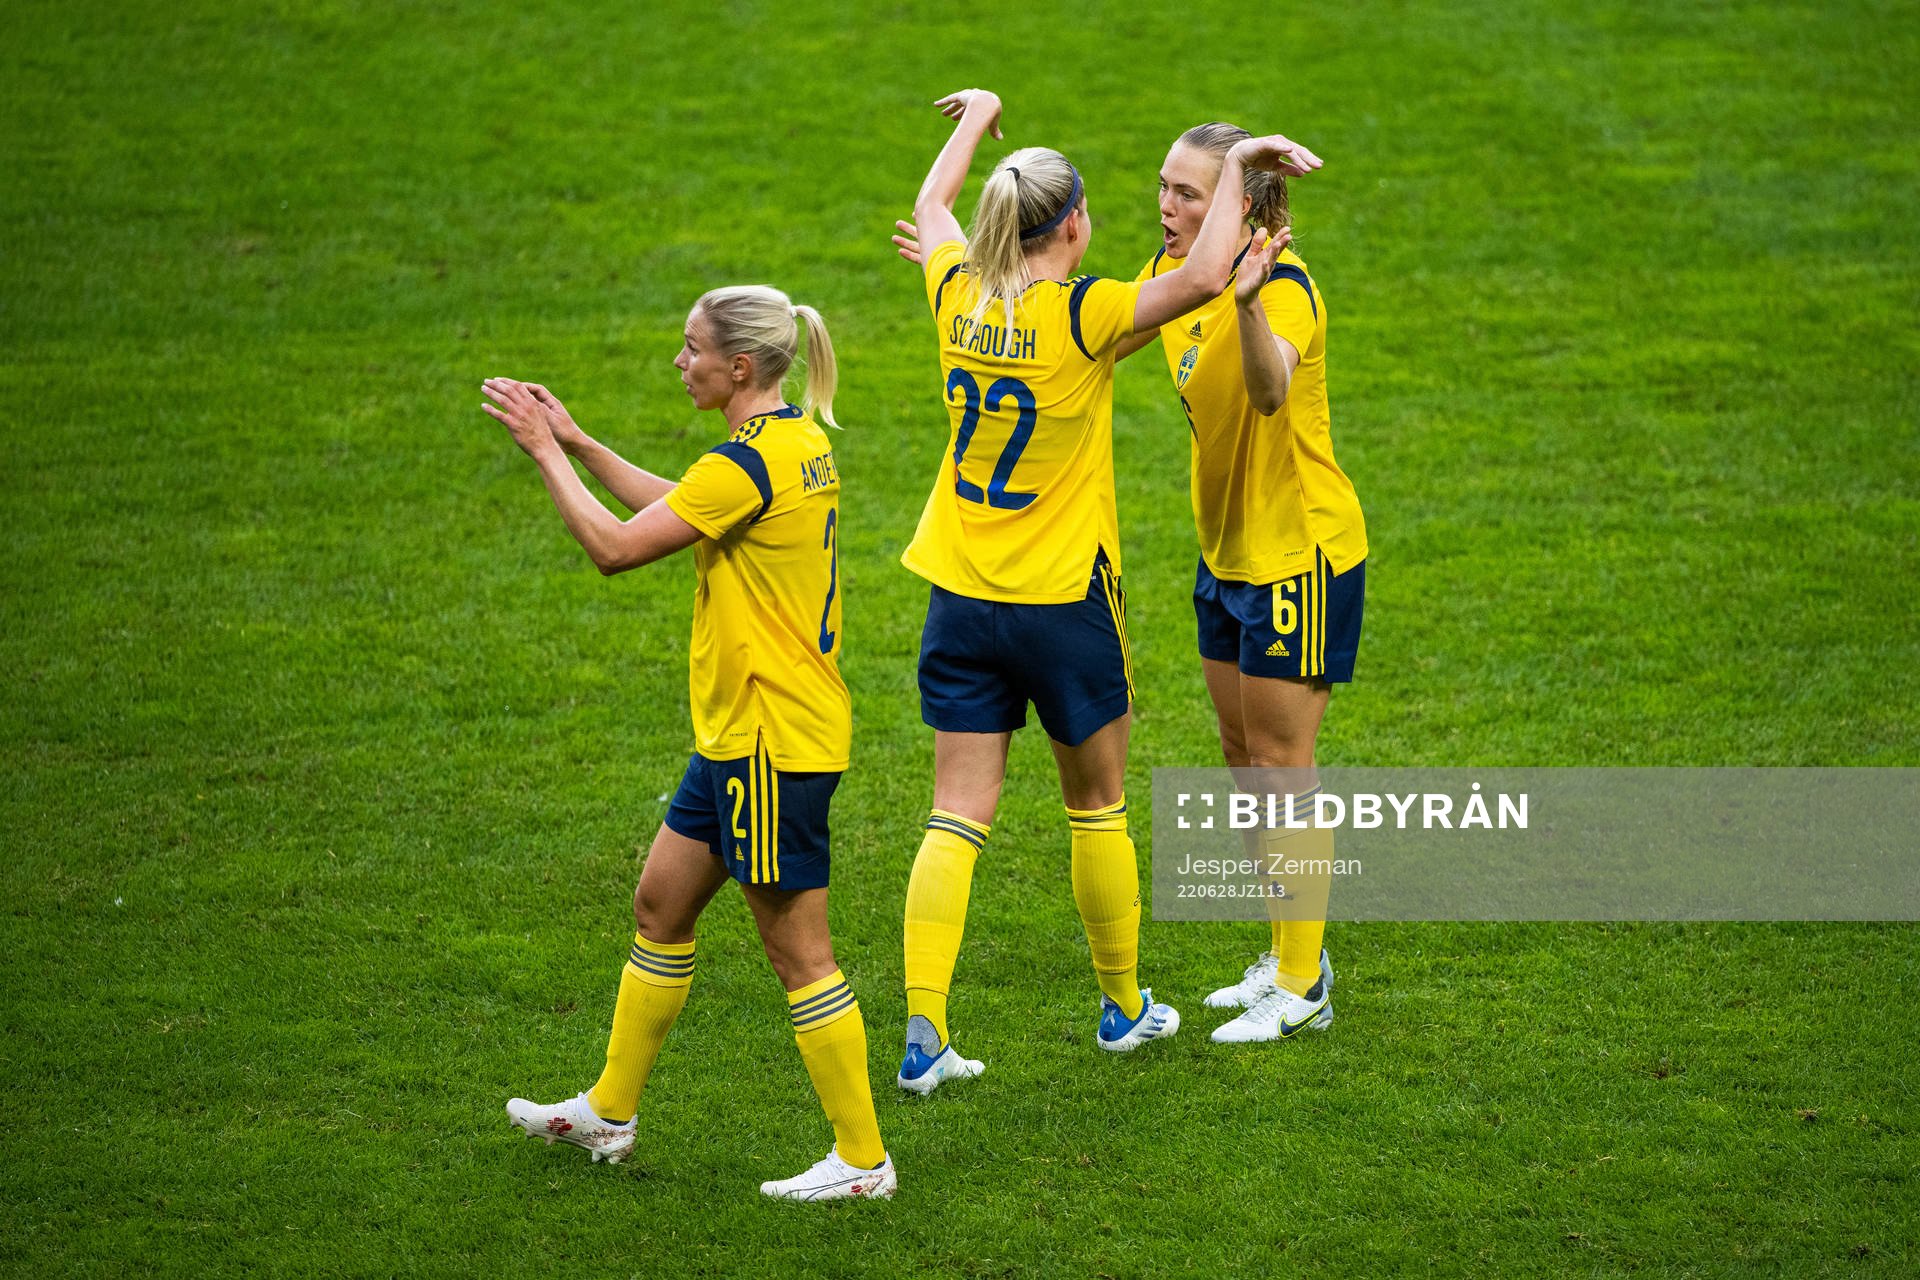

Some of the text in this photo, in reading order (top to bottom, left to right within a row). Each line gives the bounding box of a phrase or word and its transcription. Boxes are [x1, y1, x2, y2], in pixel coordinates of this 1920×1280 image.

[950, 314, 1036, 360] SCHOUGH
[946, 367, 1039, 511] 22
[818, 507, 837, 655] 2
[1272, 579, 1298, 635] 6
[726, 776, 747, 839] 2
